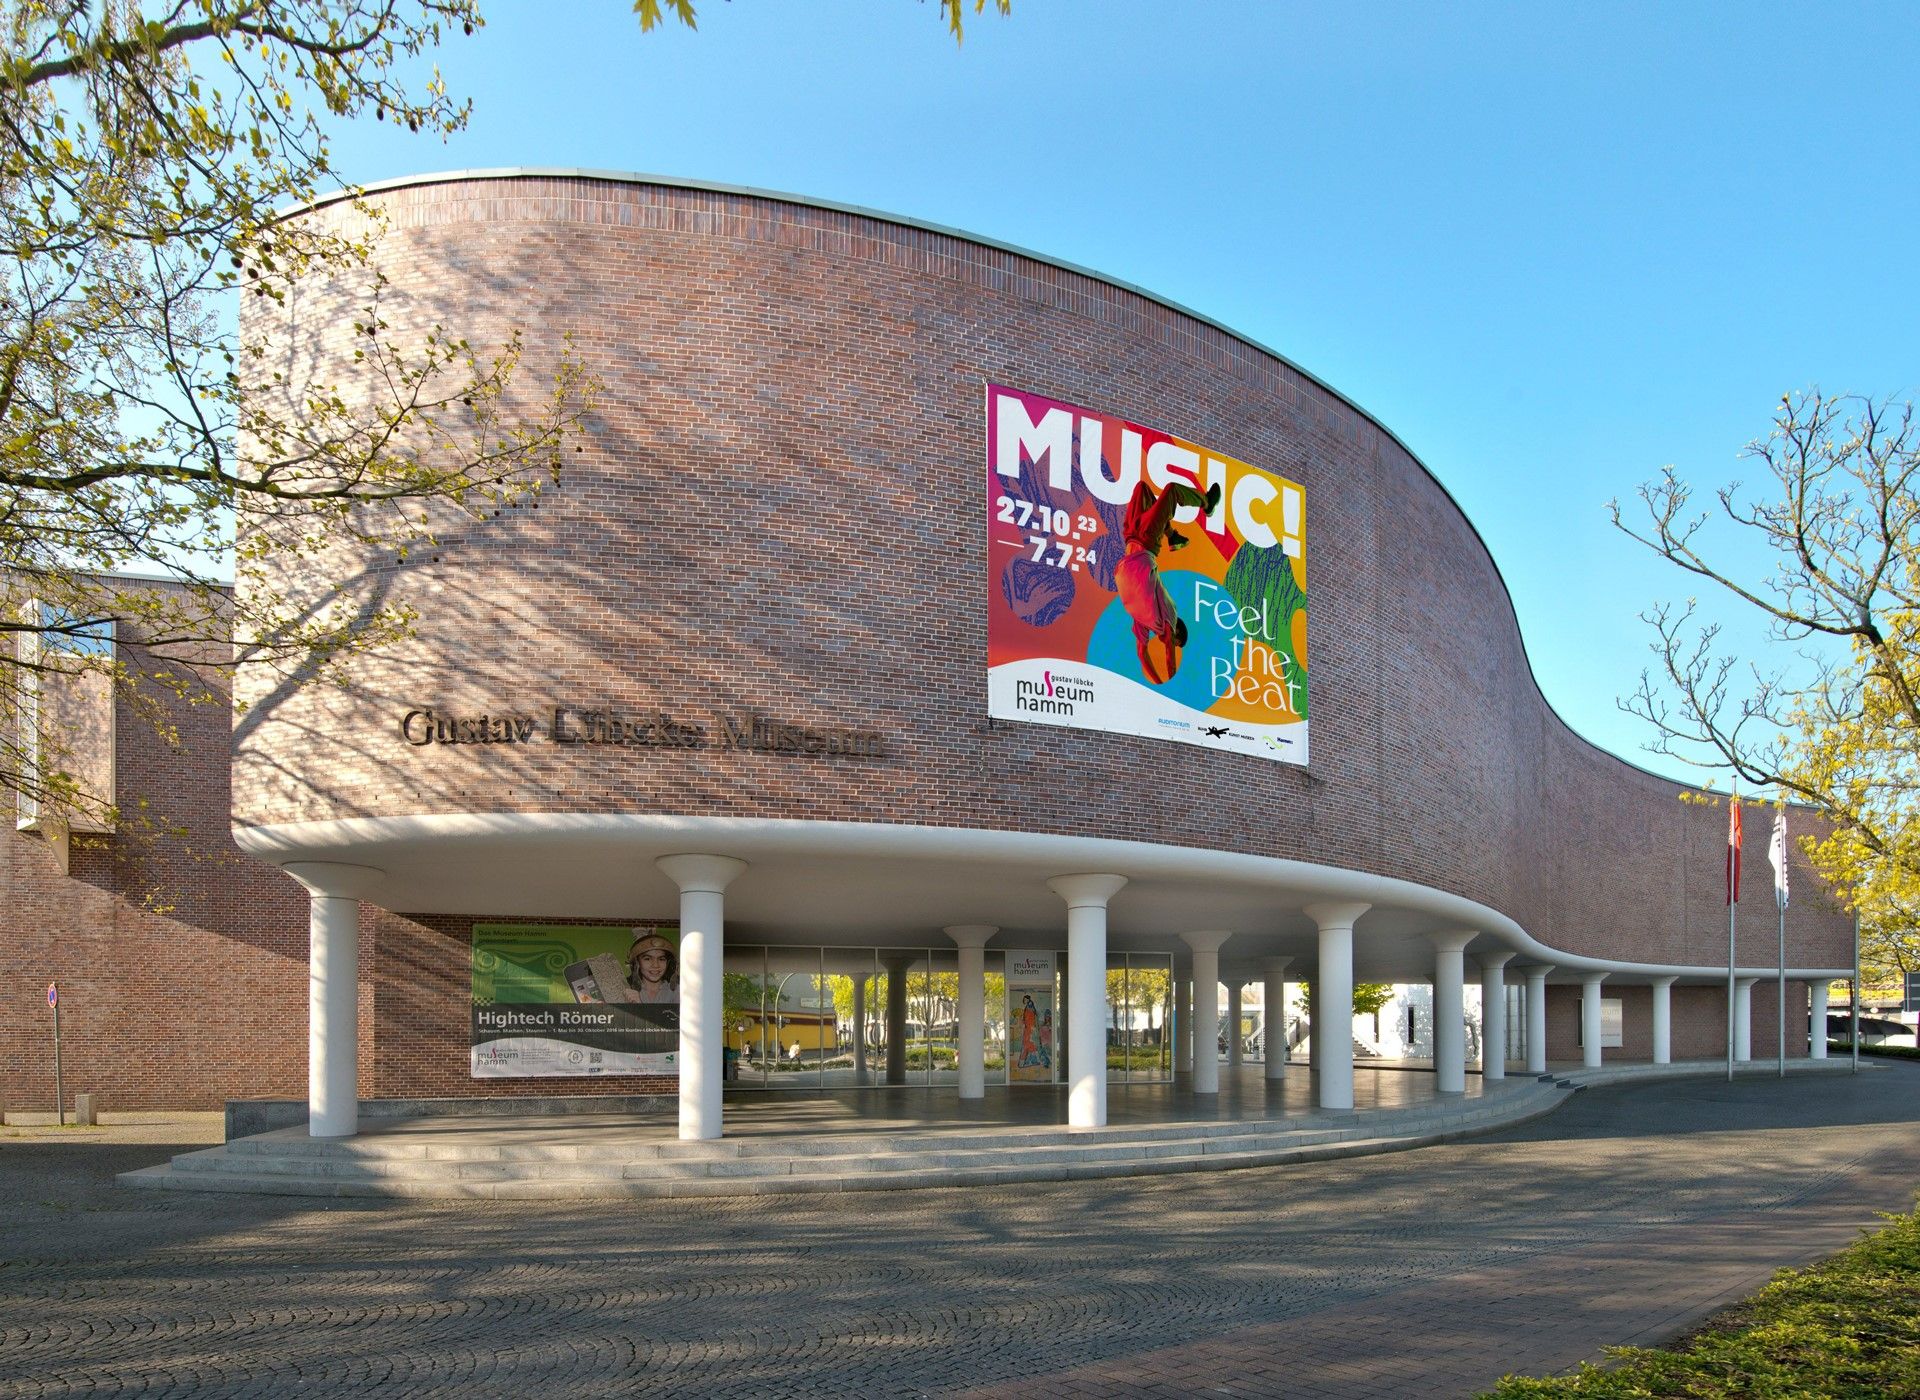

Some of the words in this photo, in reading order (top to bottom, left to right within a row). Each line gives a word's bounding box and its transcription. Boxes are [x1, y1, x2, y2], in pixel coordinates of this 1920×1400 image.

[996, 394, 1301, 559] MUSIC!
[1194, 580, 1277, 640] Feel
[1051, 675, 1073, 683] gustav
[1073, 677, 1094, 687] lübcke
[1229, 636, 1291, 681] the
[1016, 696, 1073, 716] hamm
[1210, 656, 1302, 715] Beat
[402, 706, 532, 746] Gustav
[544, 704, 700, 749] Lübcke
[714, 711, 885, 757] Museum
[478, 1011, 554, 1028] Hightech
[560, 1011, 614, 1025] Römer
[478, 1058, 508, 1066] hamm
